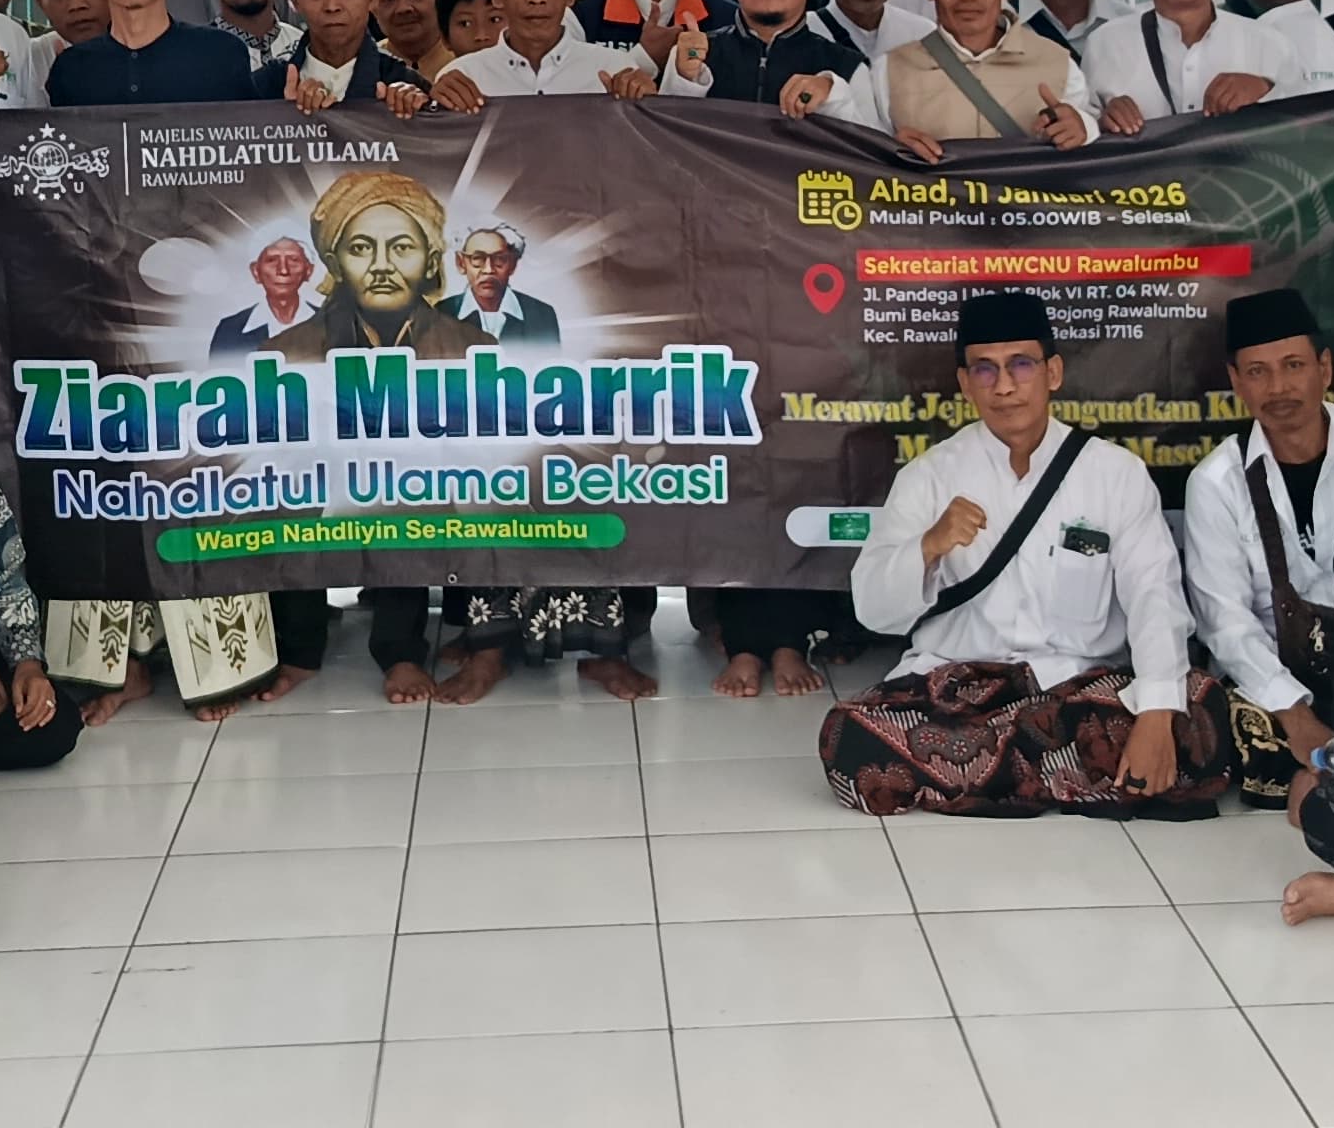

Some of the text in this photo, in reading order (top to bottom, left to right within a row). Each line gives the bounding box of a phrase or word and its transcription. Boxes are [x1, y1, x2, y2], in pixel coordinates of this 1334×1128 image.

[140, 124, 328, 145] MAJELIS WAKIL CABANG
[141, 141, 400, 169] NAHDLATUL ULAMA
[13, 181, 84, 196] N U
[142, 169, 245, 187] RAWALUMBU
[869, 177, 956, 207] Ahad,
[964, 180, 988, 204] 11
[1110, 182, 1187, 207] 2026
[869, 209, 924, 225] Mulai
[929, 210, 985, 226] Pukul
[1001, 210, 1101, 226] 05.00WIB
[1121, 208, 1192, 225] Selesai
[864, 253, 1199, 275] Sekretariat MWCNU Rawalumbu
[885, 287, 958, 305] Pandega
[1086, 285, 1112, 299] RT.
[1116, 283, 1136, 298] 04
[1141, 282, 1173, 297] RW.
[1177, 282, 1200, 297] 07
[863, 302, 1208, 324] Bumi Bekas Bojong Rawalumbu
[863, 328, 899, 343] Kec.
[1051, 324, 1101, 340] Bekasi
[1105, 324, 1144, 340] 17116
[19, 352, 754, 455] Ziarah Muharrik
[780, 391, 916, 423] Merawat
[917, 391, 979, 427] Jeja
[1048, 391, 1203, 430] enguatkan
[56, 457, 725, 518] Nahdlatul Ulama Bekasi
[195, 518, 588, 553] Warga Nahdliyin Se-Rawalumbu
